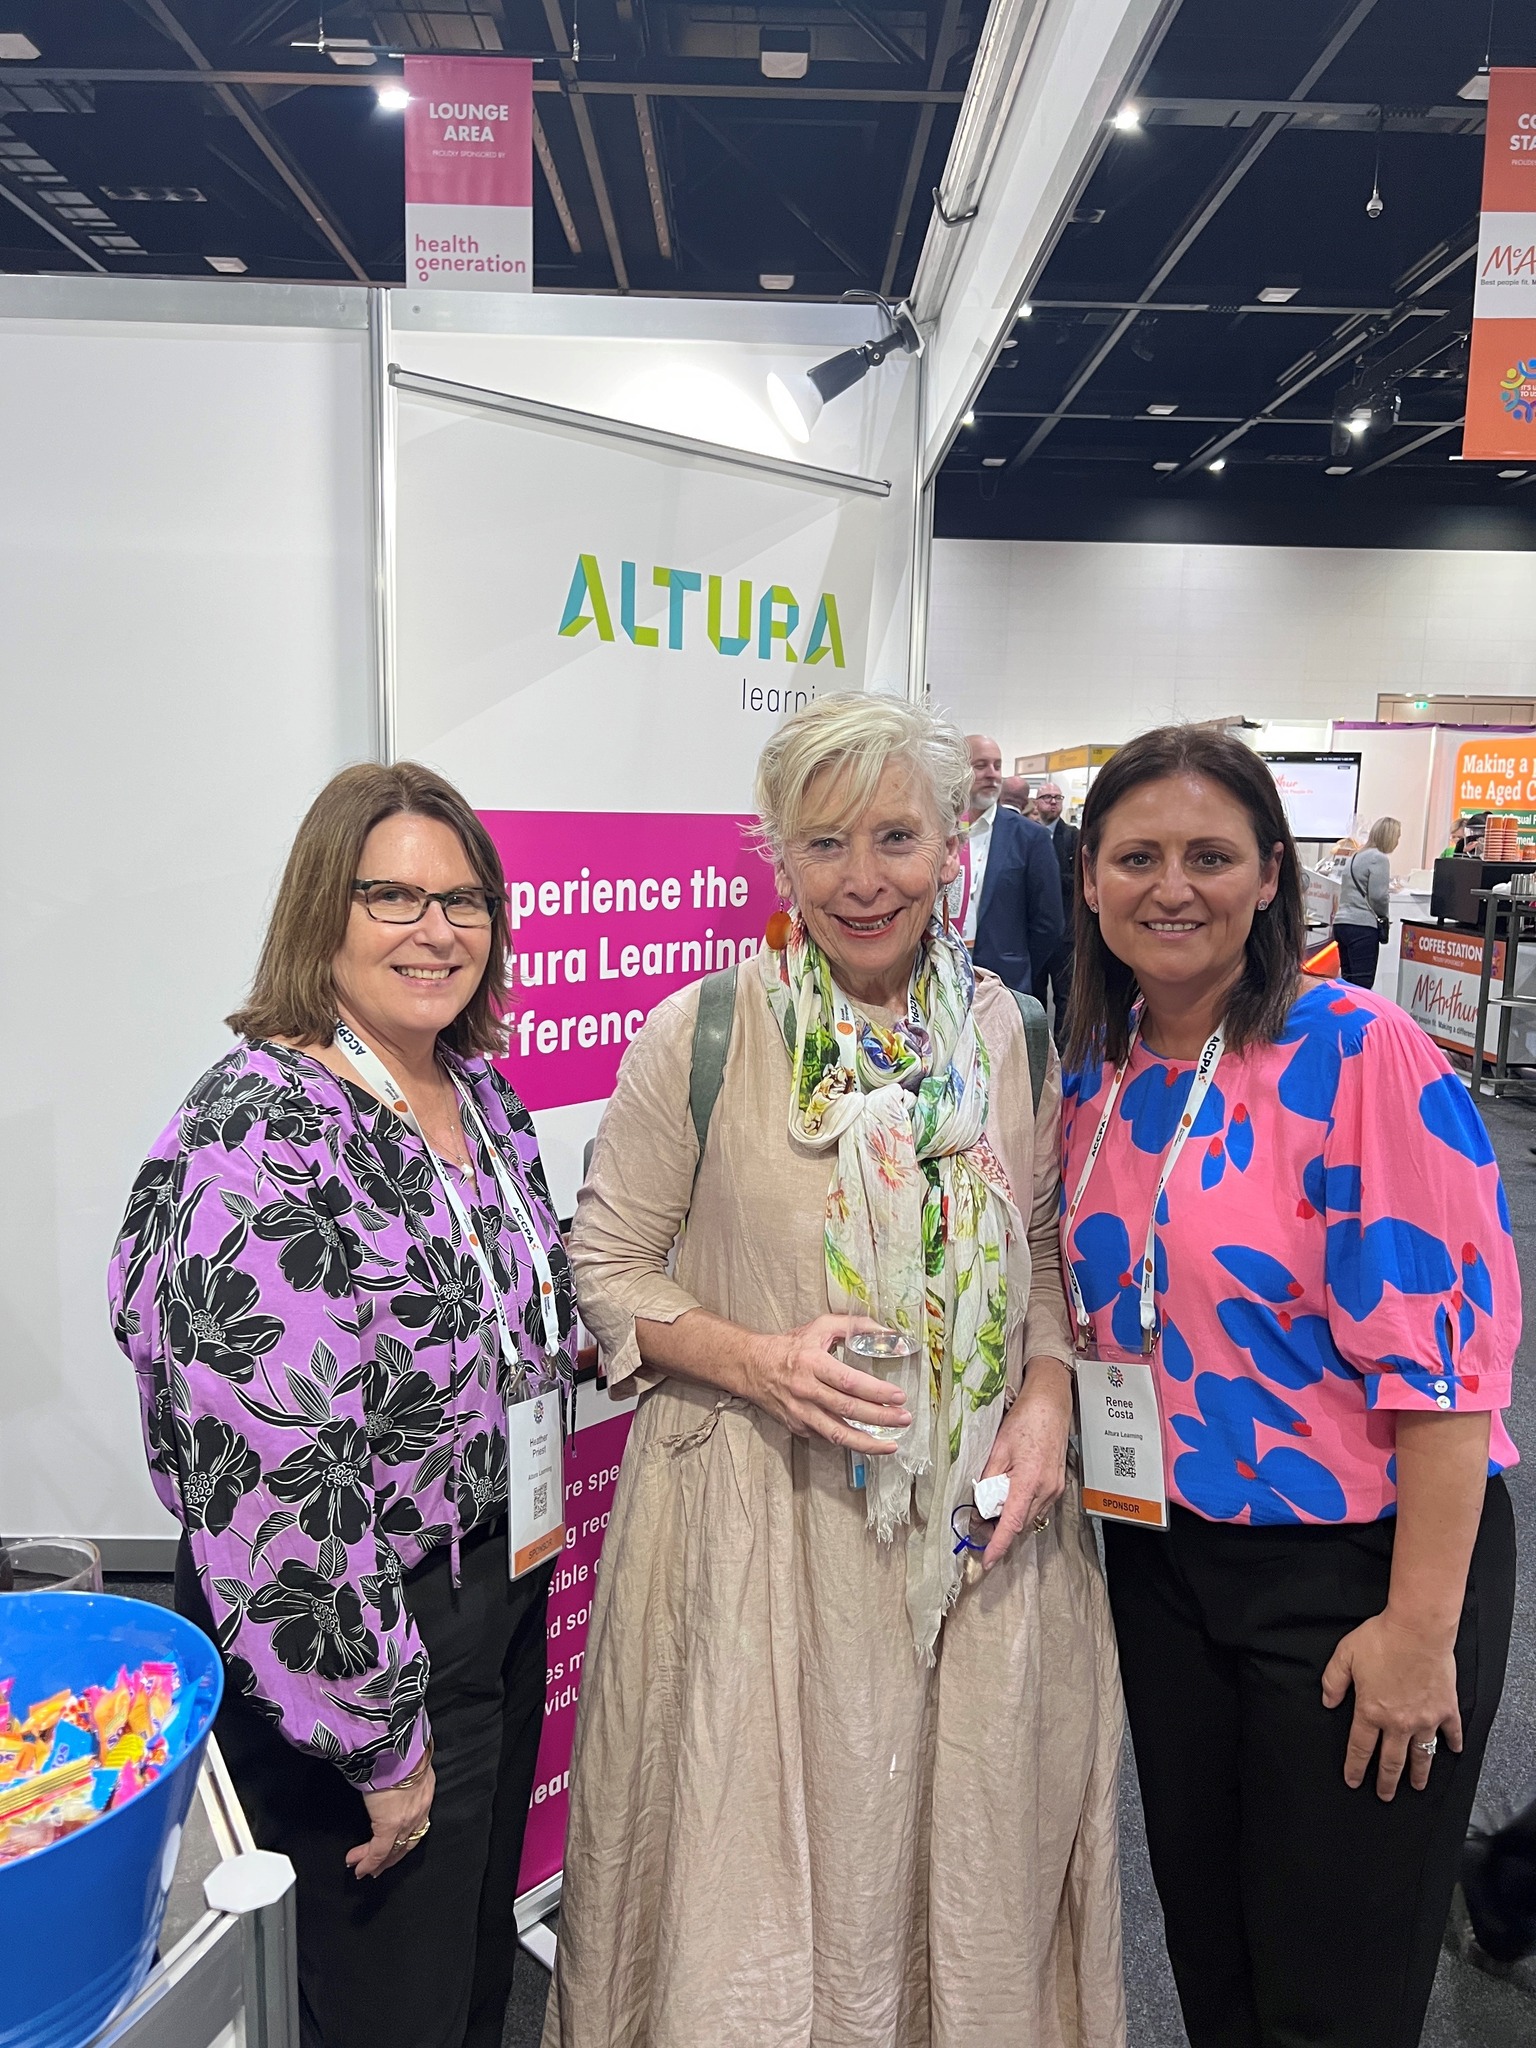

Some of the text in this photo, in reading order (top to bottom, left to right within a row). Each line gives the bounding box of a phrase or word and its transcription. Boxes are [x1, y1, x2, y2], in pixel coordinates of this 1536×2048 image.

[430, 103, 508, 121] LOUNGE
[443, 125, 494, 142] AREA
[415, 233, 479, 253] health
[415, 254, 526, 282] generation
[558, 553, 846, 668] ALTURA
[742, 678, 821, 713] learn
[1463, 753, 1515, 779] Making
[1519, 758, 1528, 773] a
[1461, 780, 1482, 800] the
[1485, 780, 1522, 806] Aged
[504, 866, 749, 930] perience the
[1419, 936, 1446, 954] COFFEE
[1446, 941, 1483, 962] STATION
[909, 993, 920, 1023] ACCPA
[1411, 974, 1479, 1022] McArthur
[489, 1008, 650, 1060] fferenc
[1198, 1036, 1220, 1074] ACCPA
[1091, 1119, 1107, 1157] ACCPA
[512, 1206, 534, 1244] ACCPA
[1105, 1396, 1133, 1409] Renee
[1108, 1408, 1134, 1420] Costa
[529, 1433, 548, 1448] Heather
[1104, 1429, 1143, 1441] Altura Learning
[532, 1445, 546, 1458] Priest
[588, 1464, 619, 1492] spe
[1102, 1498, 1140, 1514] SPONSOR
[547, 1615, 560, 1640] d
